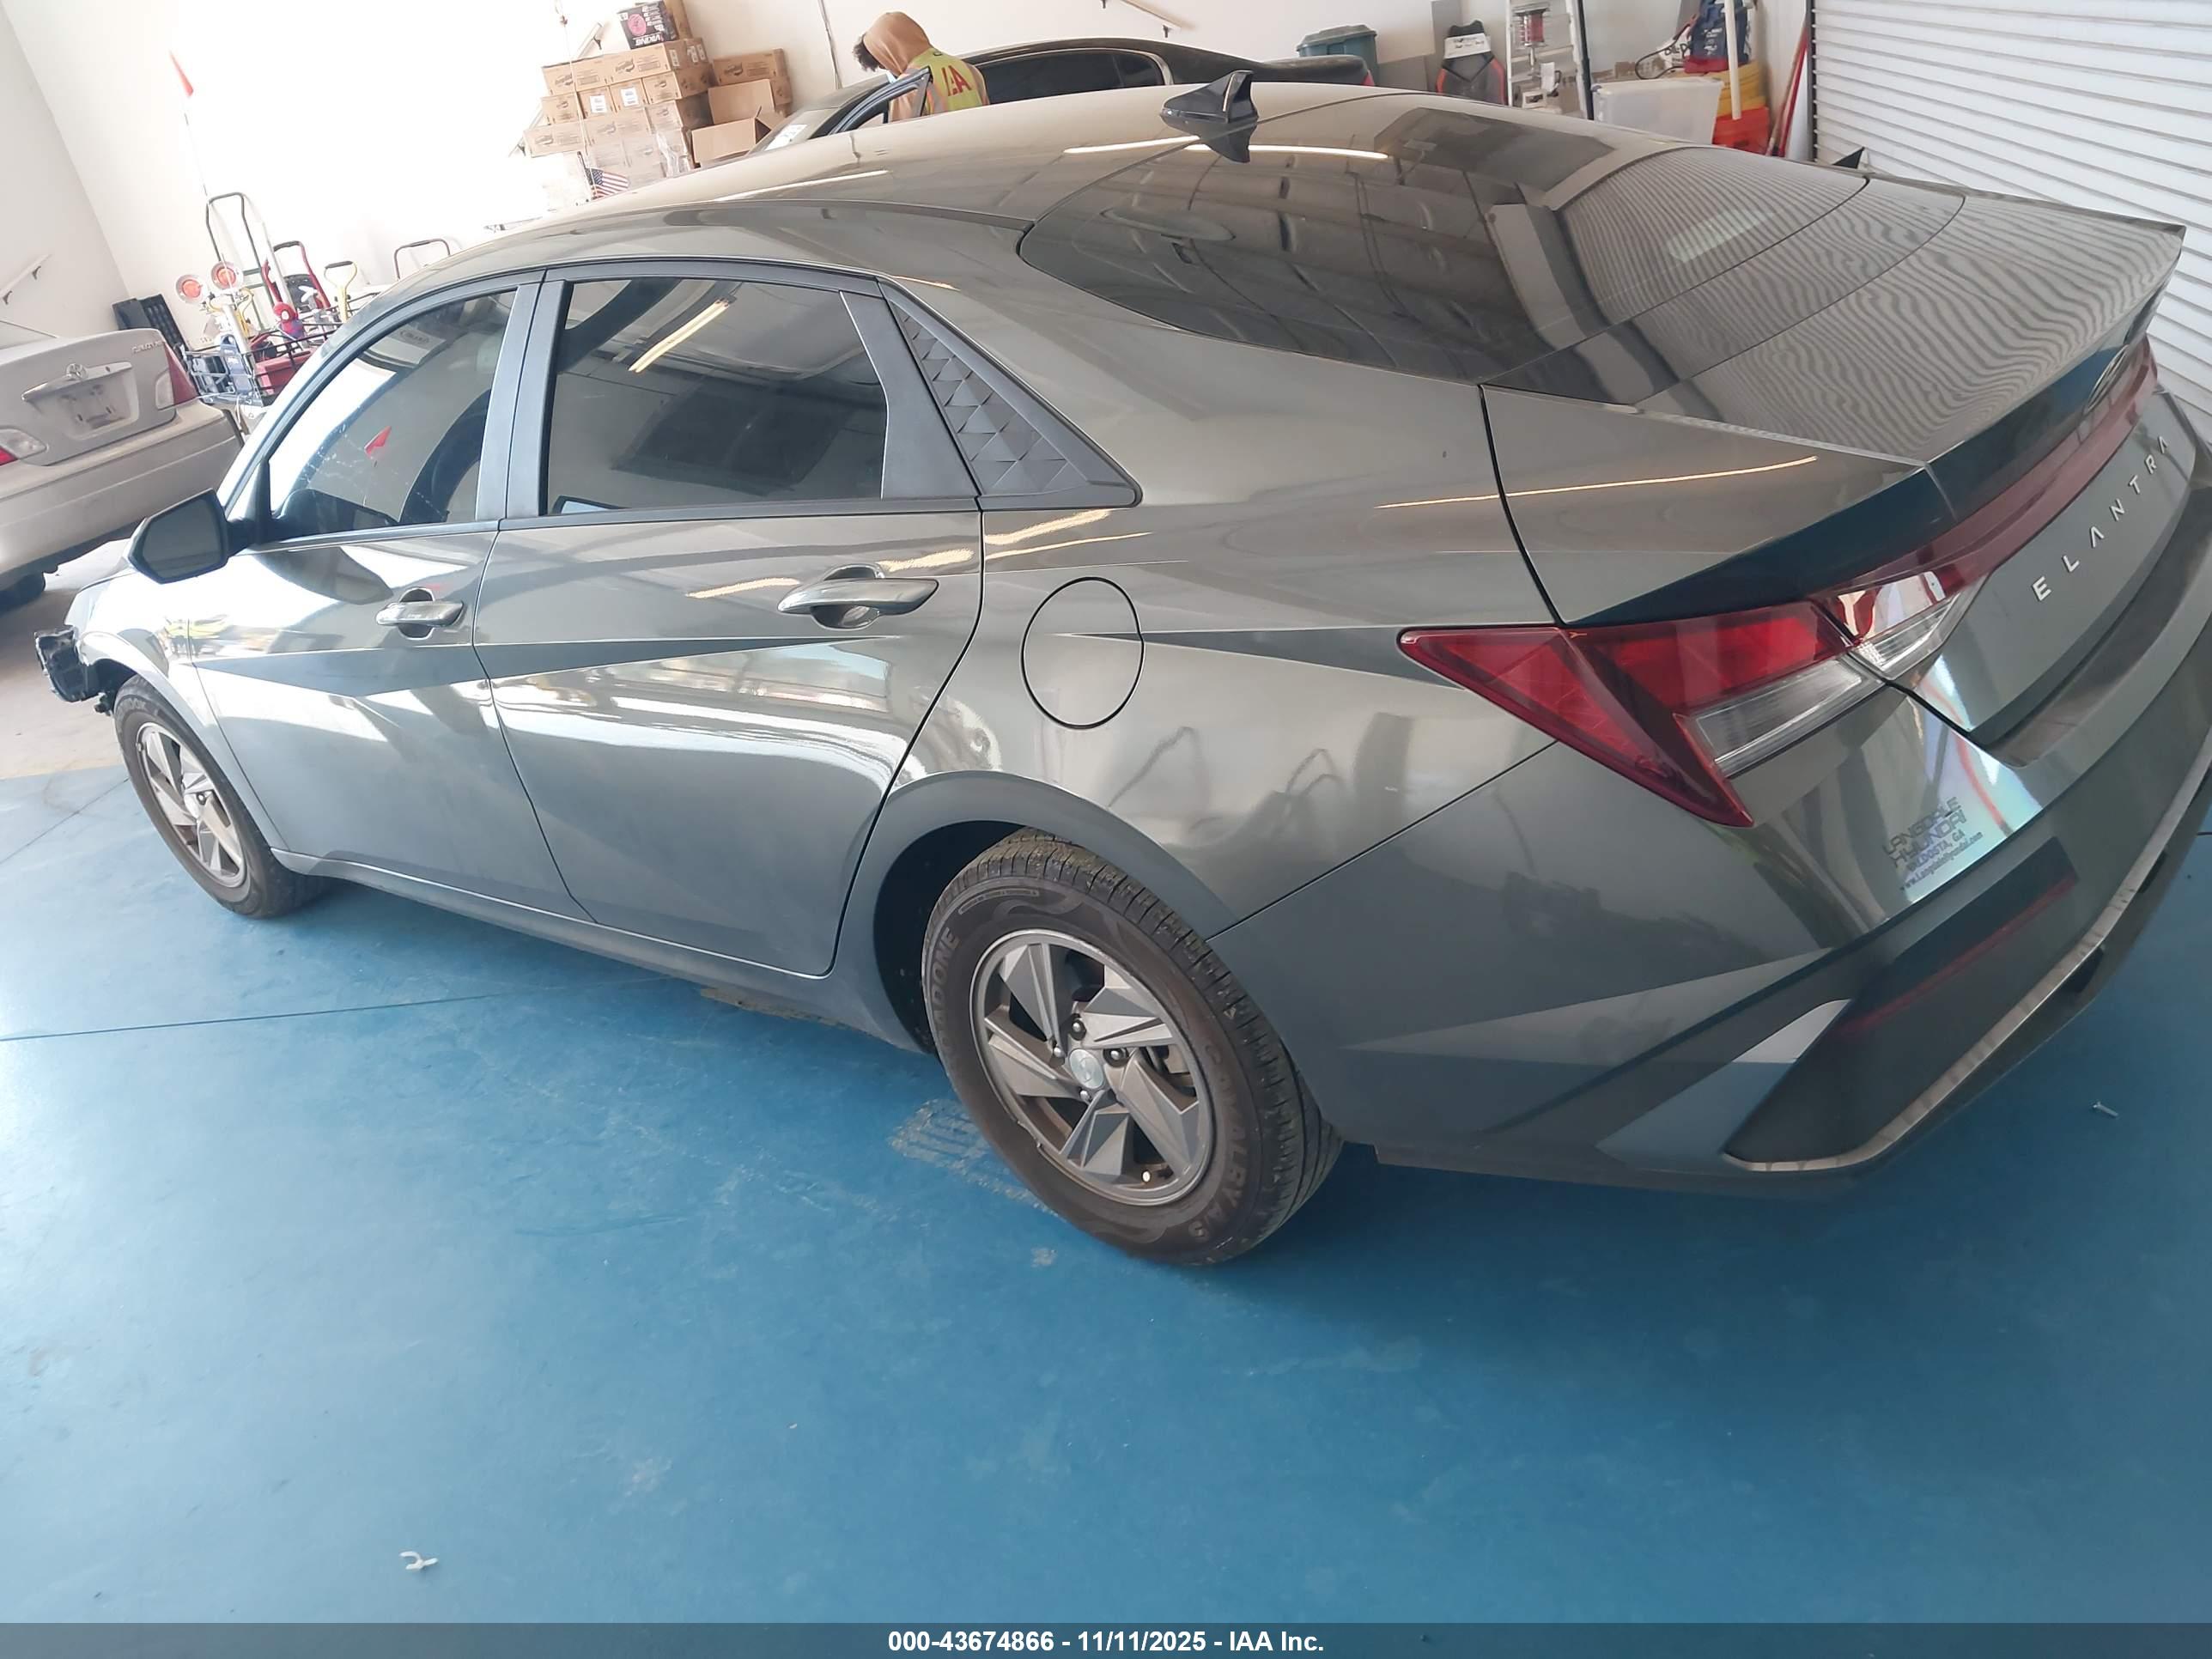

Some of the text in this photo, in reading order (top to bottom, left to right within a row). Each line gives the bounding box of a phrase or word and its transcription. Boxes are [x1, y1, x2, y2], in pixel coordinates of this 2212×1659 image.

[635, 33, 661, 46] VIKING
[2031, 435, 2168, 601] ELANTRA
[1882, 796, 1961, 855] LANGDALE
[1889, 809, 1967, 868] HYUNDAI
[1952, 830, 1966, 842] GA
